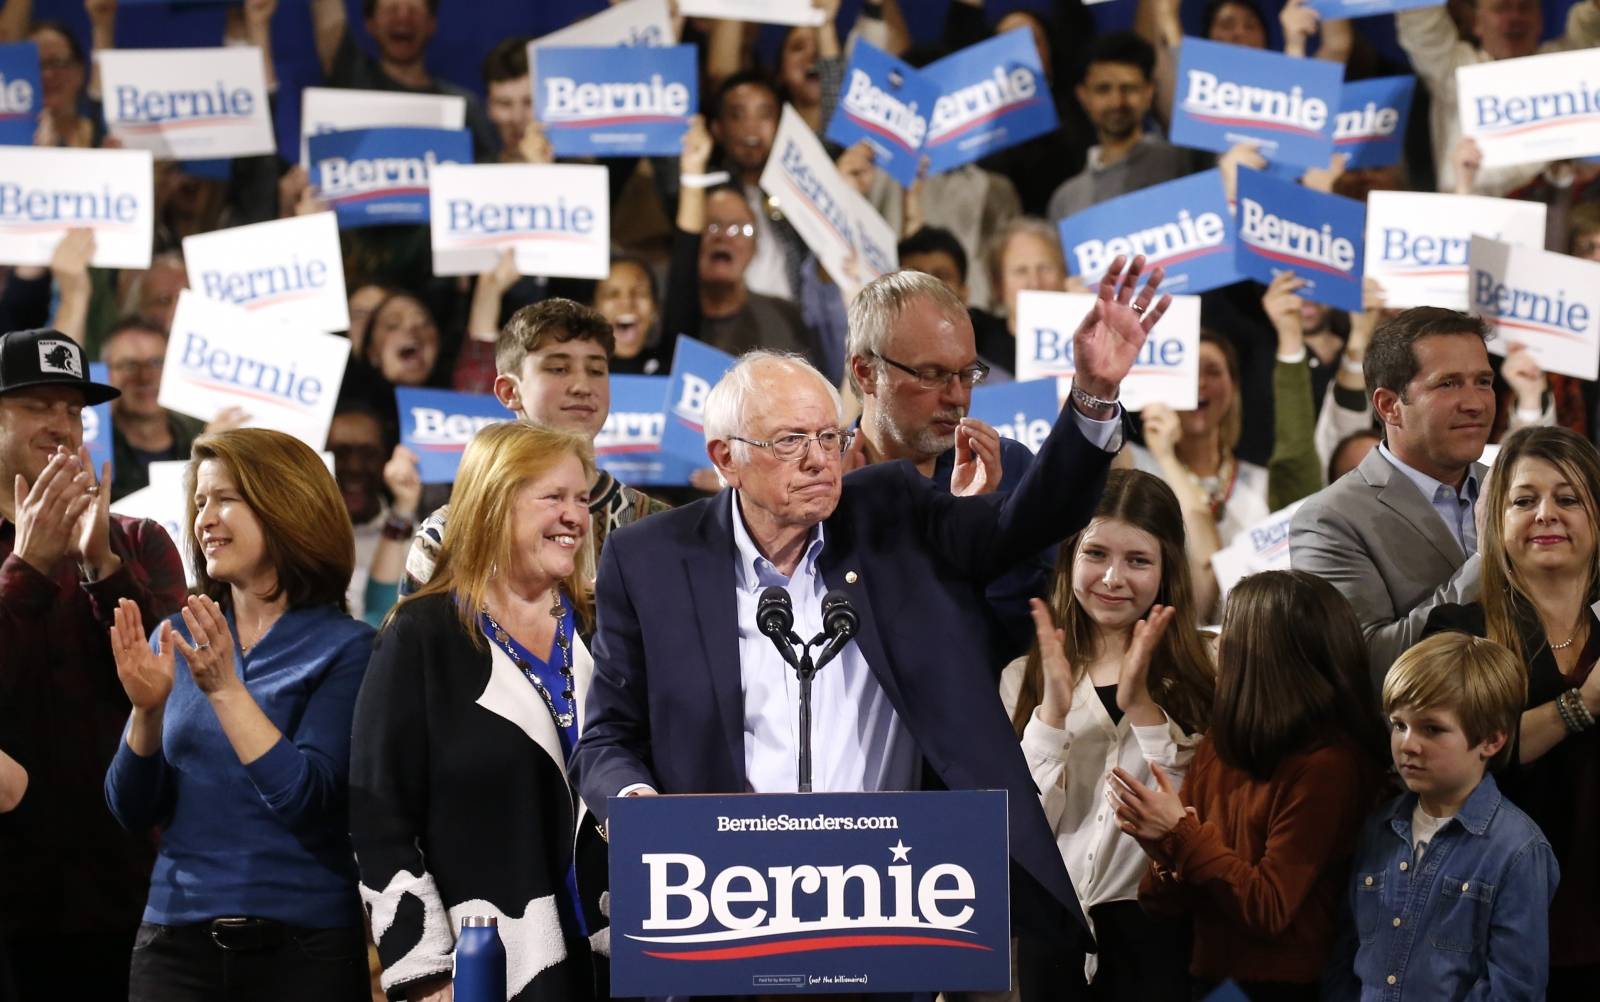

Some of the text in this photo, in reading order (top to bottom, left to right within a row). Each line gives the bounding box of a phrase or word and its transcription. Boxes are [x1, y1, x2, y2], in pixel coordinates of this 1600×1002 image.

[115, 80, 253, 121] Bernie
[544, 74, 689, 115] Bernie
[843, 67, 927, 149] Bernie
[930, 66, 1036, 130] ernie
[1187, 68, 1328, 131] Bernie
[1334, 102, 1398, 137] nie
[0, 180, 138, 223] Bernie
[448, 198, 594, 234] Bernie
[1242, 199, 1355, 271] Bernie
[1382, 228, 1471, 266] Ber
[202, 255, 328, 303] Bernie
[1475, 269, 1590, 334] Bernie
[181, 332, 322, 406] Bernie
[1033, 327, 1185, 368] Beie
[717, 814, 898, 832] BernieSanders.com
[642, 839, 976, 930] Bernie
[822, 975, 833, 984] the
[834, 974, 868, 984] billionaires)
